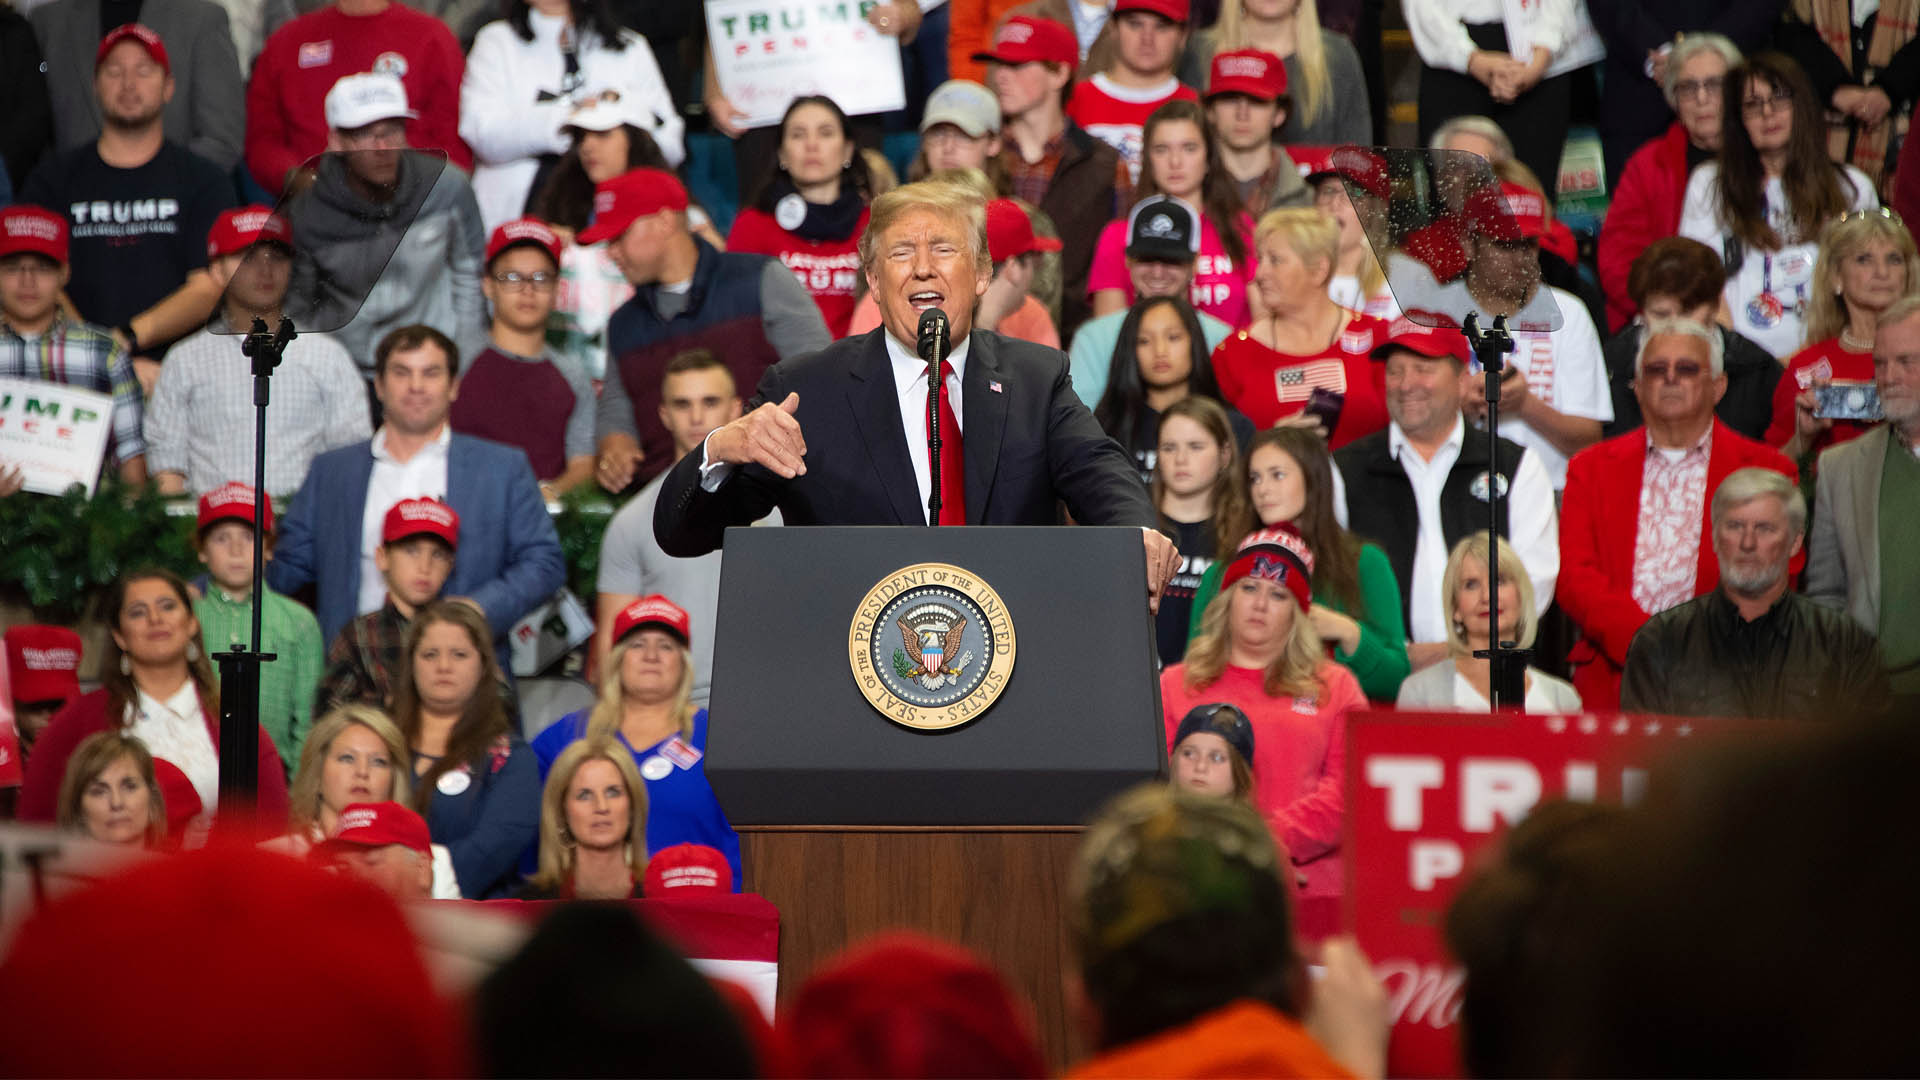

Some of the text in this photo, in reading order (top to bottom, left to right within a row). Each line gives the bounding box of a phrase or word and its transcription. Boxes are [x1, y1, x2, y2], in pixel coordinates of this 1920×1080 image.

[70, 199, 179, 224] TRUMP
[1251, 556, 1288, 584] M
[855, 570, 1010, 721] SEAL OF THE PRESIDENT OF THE UNITED STATES
